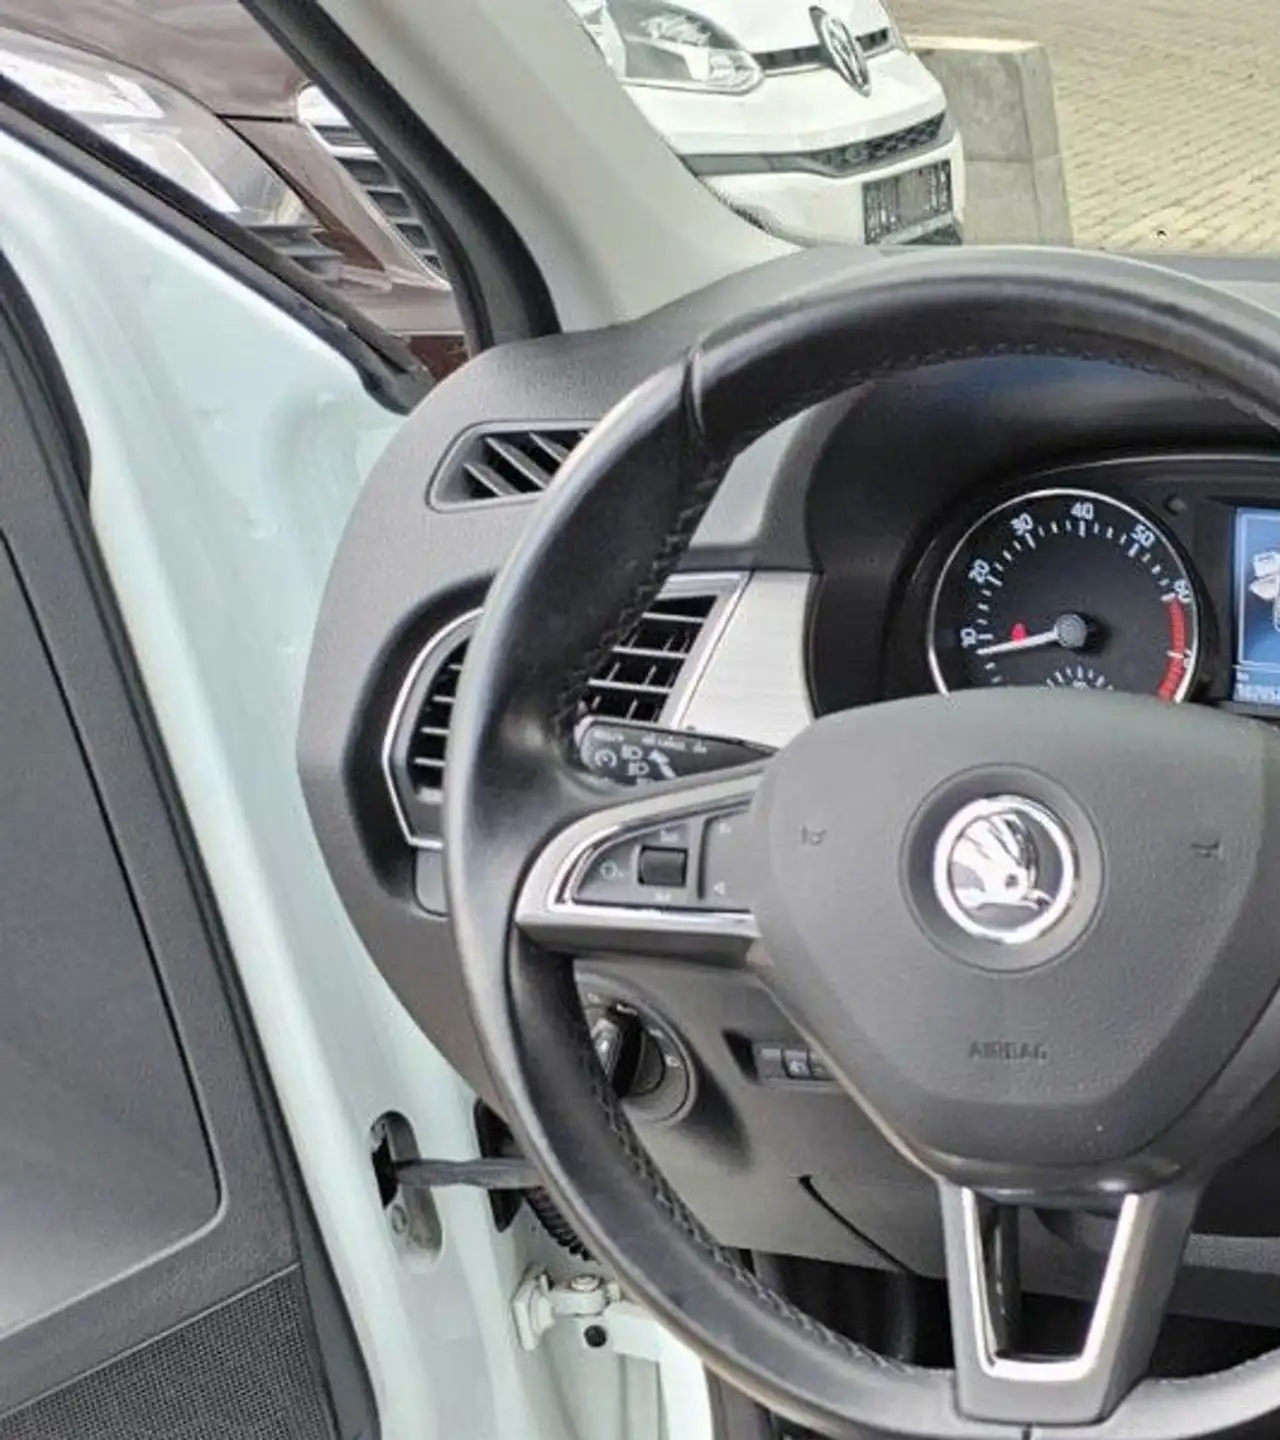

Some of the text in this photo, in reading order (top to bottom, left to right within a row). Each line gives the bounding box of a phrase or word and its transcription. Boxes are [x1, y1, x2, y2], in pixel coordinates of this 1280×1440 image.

[1070, 502, 1095, 520] 40
[1009, 512, 1034, 537] 30
[1130, 522, 1156, 550] 50
[967, 558, 991, 584] 20
[1174, 578, 1192, 603] 60
[959, 627, 978, 648] 10
[968, 1039, 1049, 1060] AIRBAG
